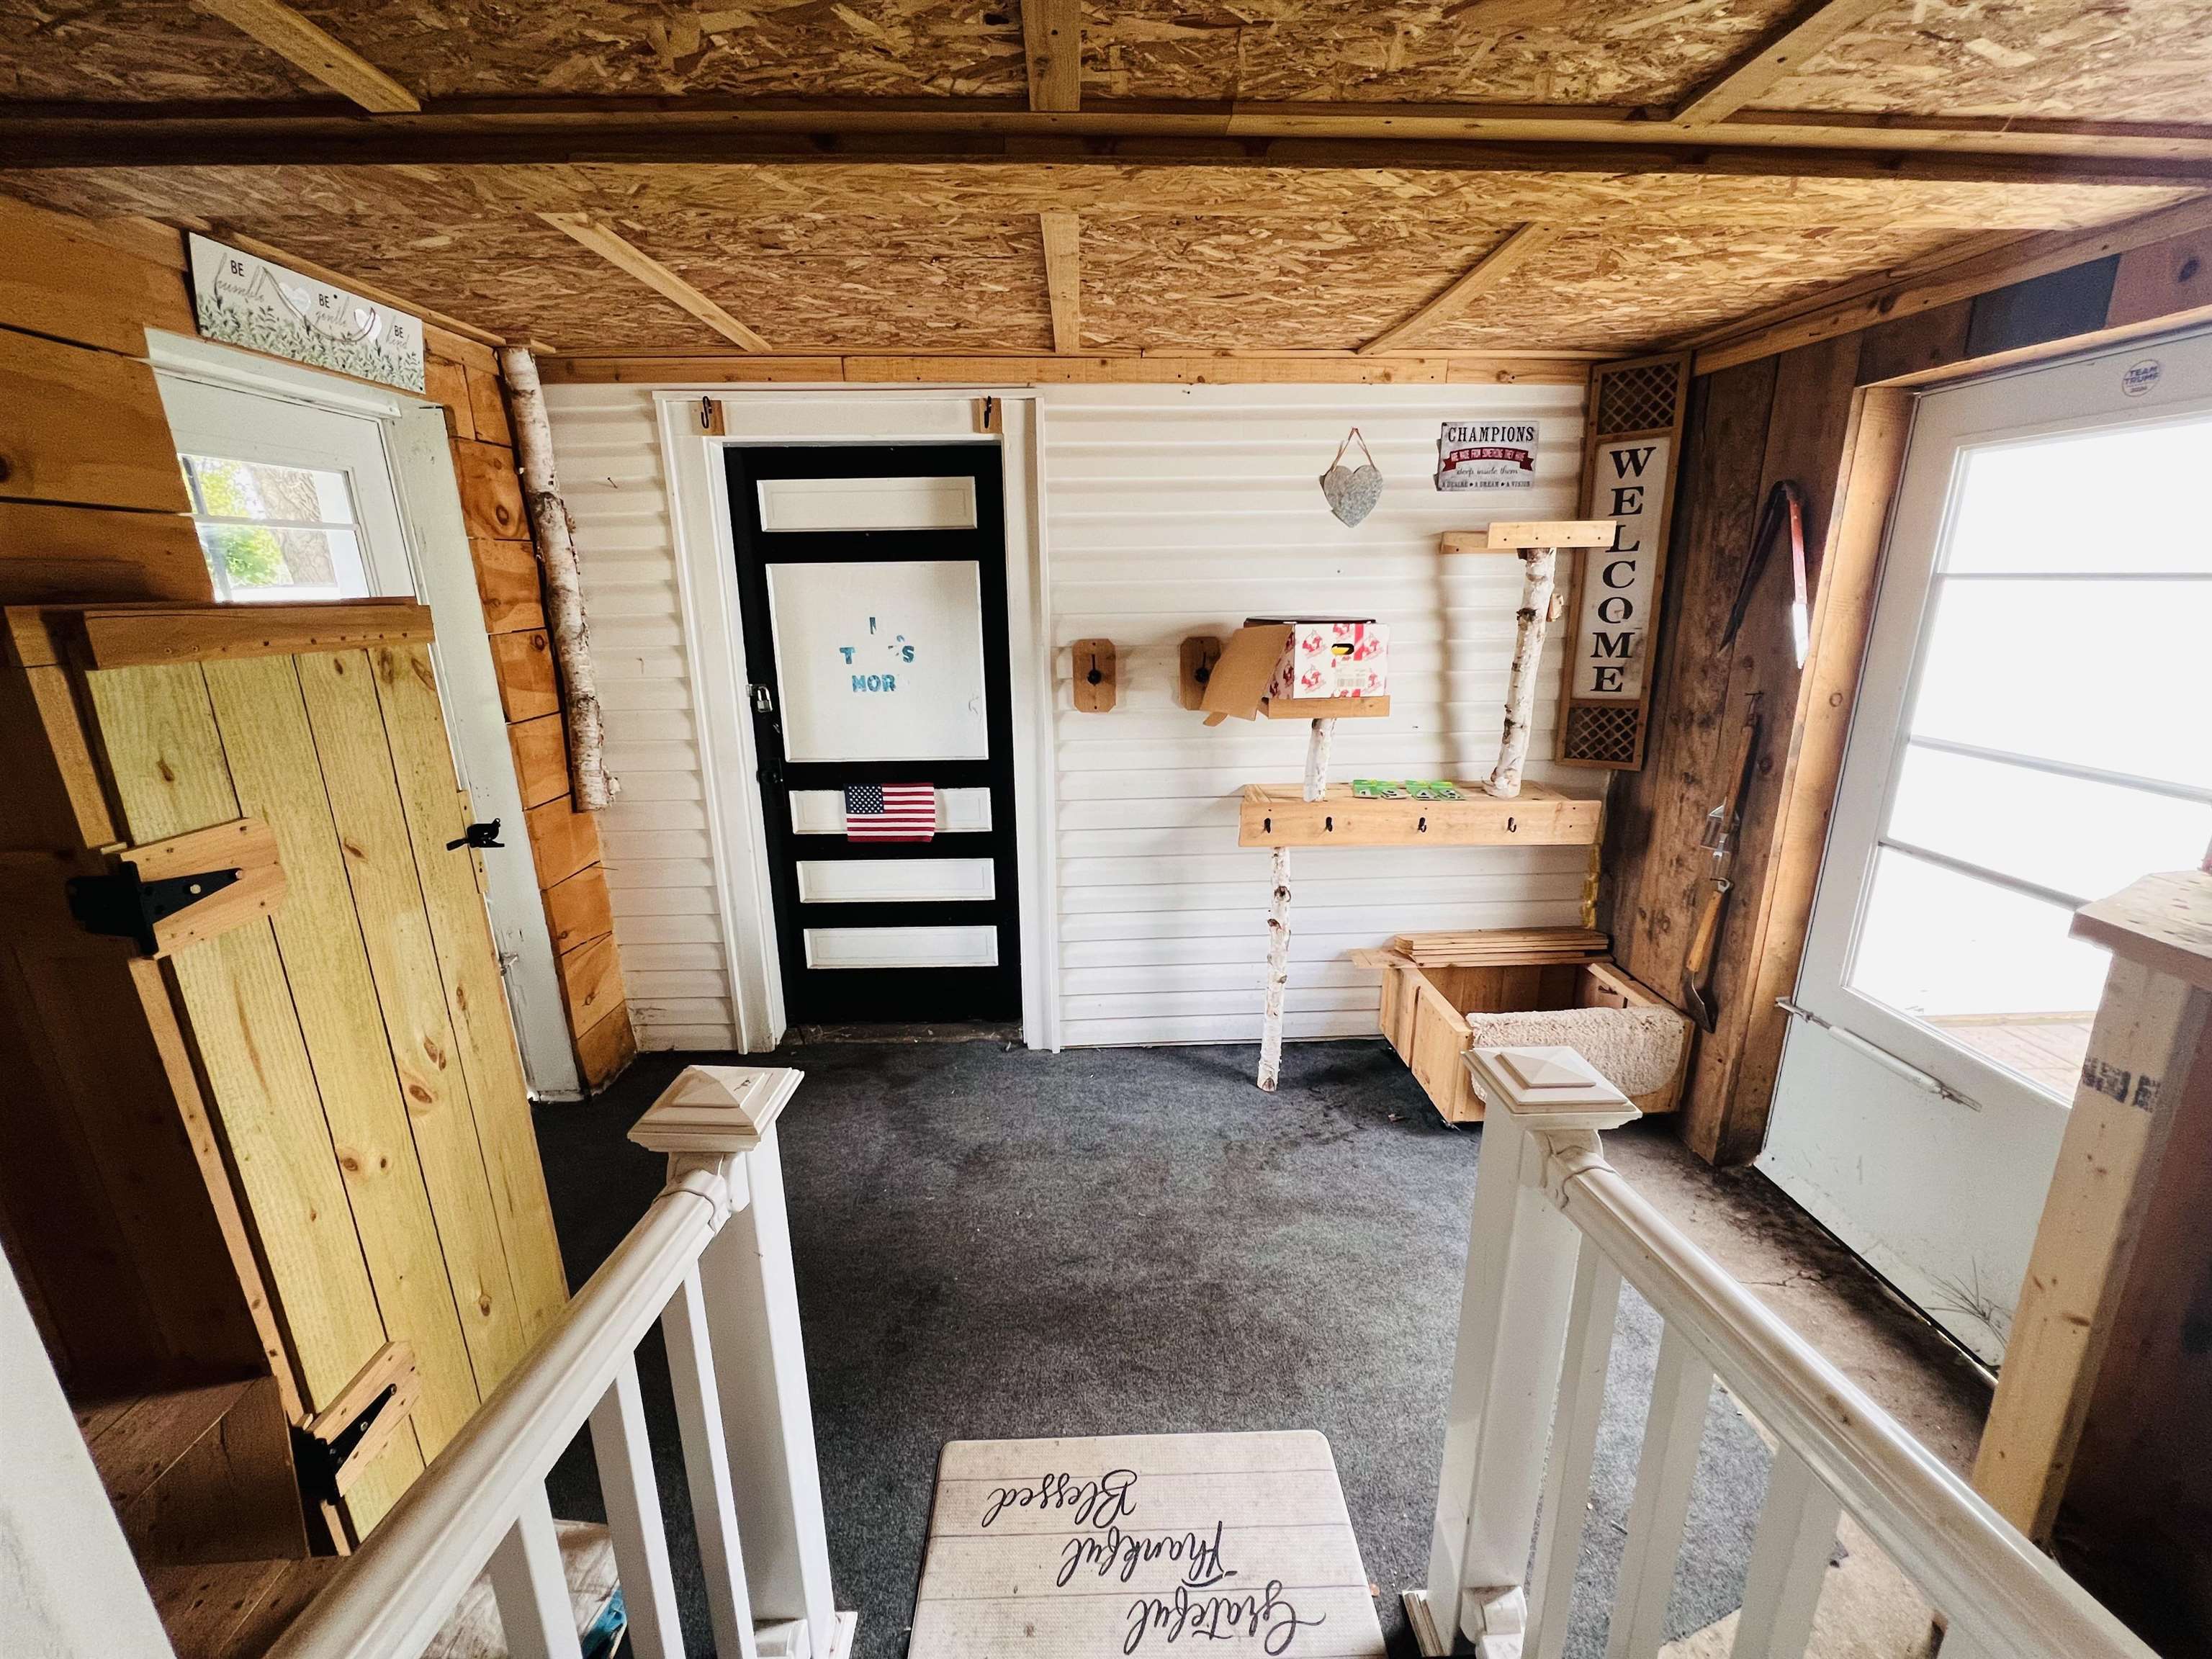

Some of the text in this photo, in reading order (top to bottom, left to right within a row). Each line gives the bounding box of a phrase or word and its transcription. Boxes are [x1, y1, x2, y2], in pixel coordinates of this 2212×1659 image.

[230, 259, 245, 277] BE
[318, 294, 331, 308] BE
[394, 325, 404, 338] BE
[2131, 366, 2158, 377] TEAM
[1448, 426, 1534, 443] CHAMPIONS
[1590, 446, 1657, 693] WELCOME
[981, 1470, 1138, 1528] Blessed
[1057, 1521, 1237, 1588] Thankful
[1123, 1580, 1326, 1656] Grateful
